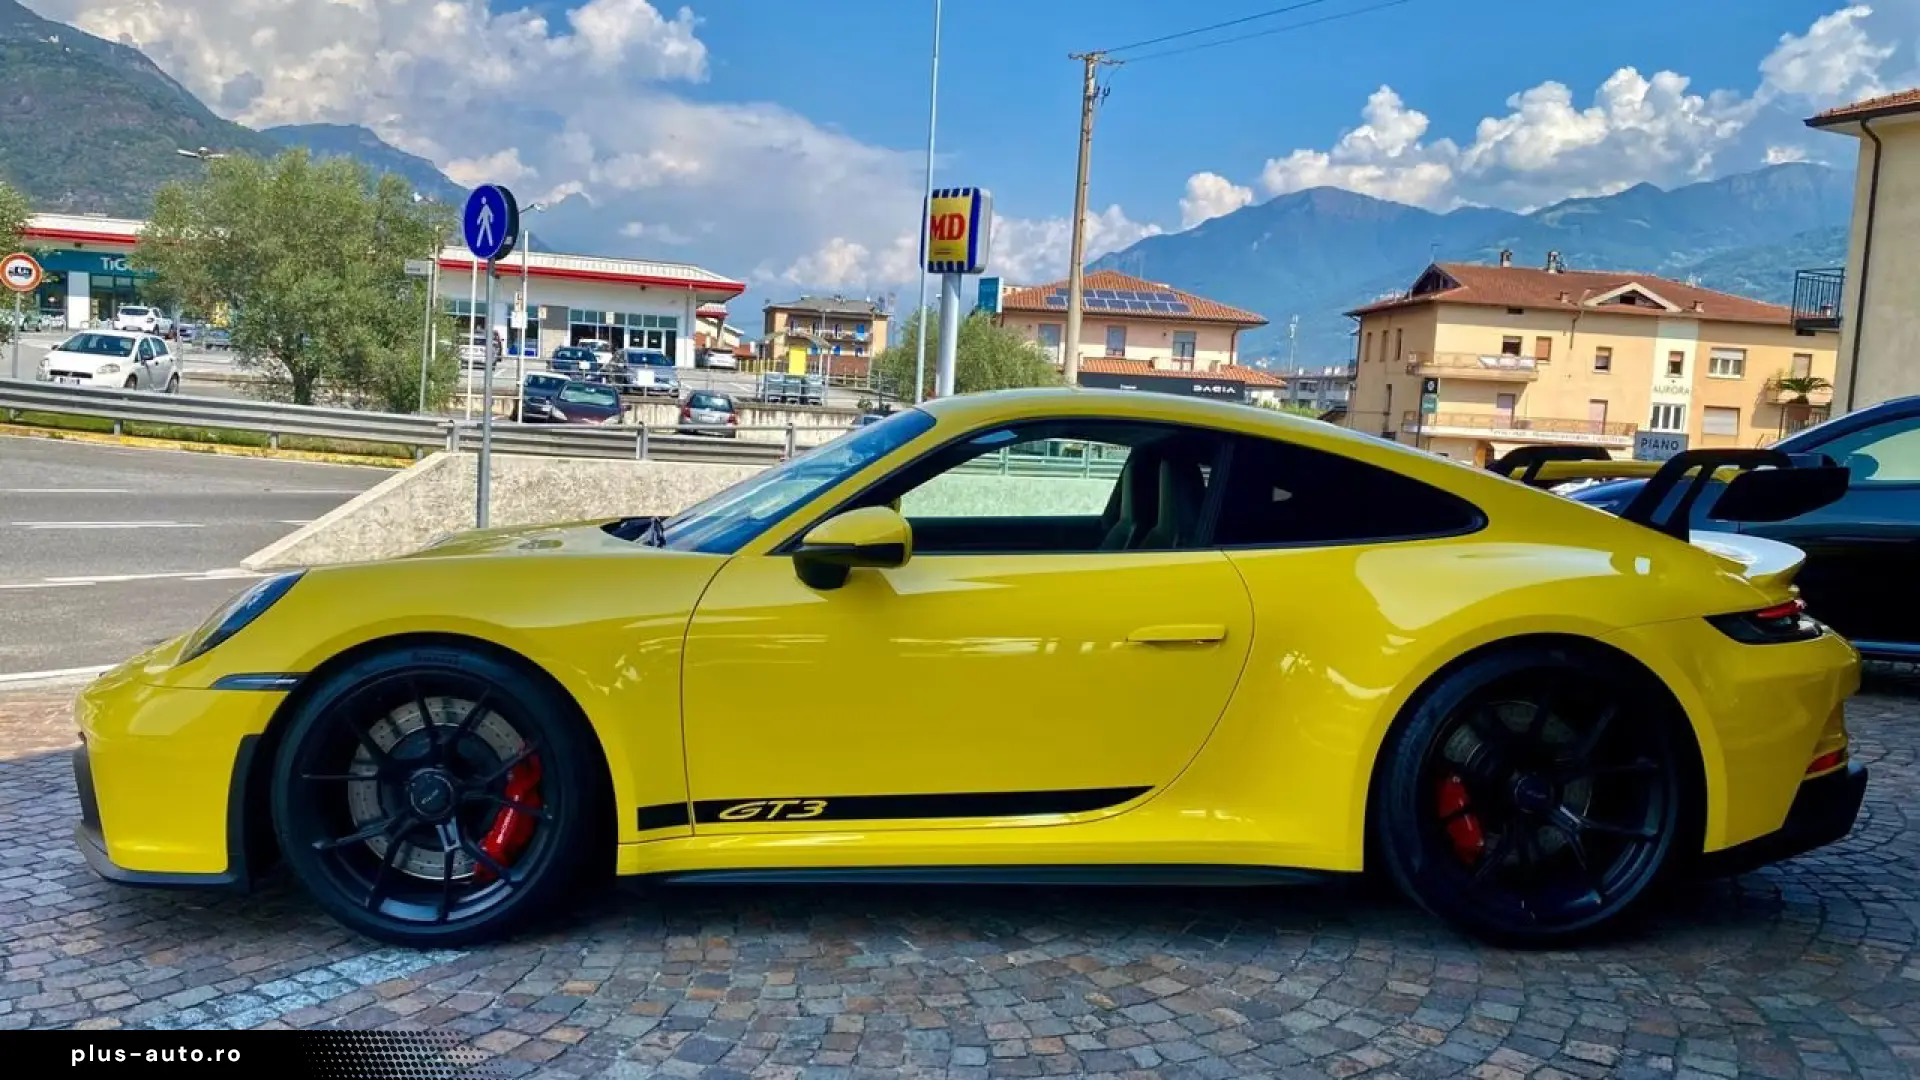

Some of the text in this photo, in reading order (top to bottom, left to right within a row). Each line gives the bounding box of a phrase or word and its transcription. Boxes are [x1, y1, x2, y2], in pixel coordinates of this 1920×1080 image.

[930, 213, 966, 240] MD
[1193, 385, 1236, 394] DACIA
[1653, 385, 1690, 396] AURORA
[1640, 437, 1679, 451] PIANO
[719, 800, 828, 819] GT3
